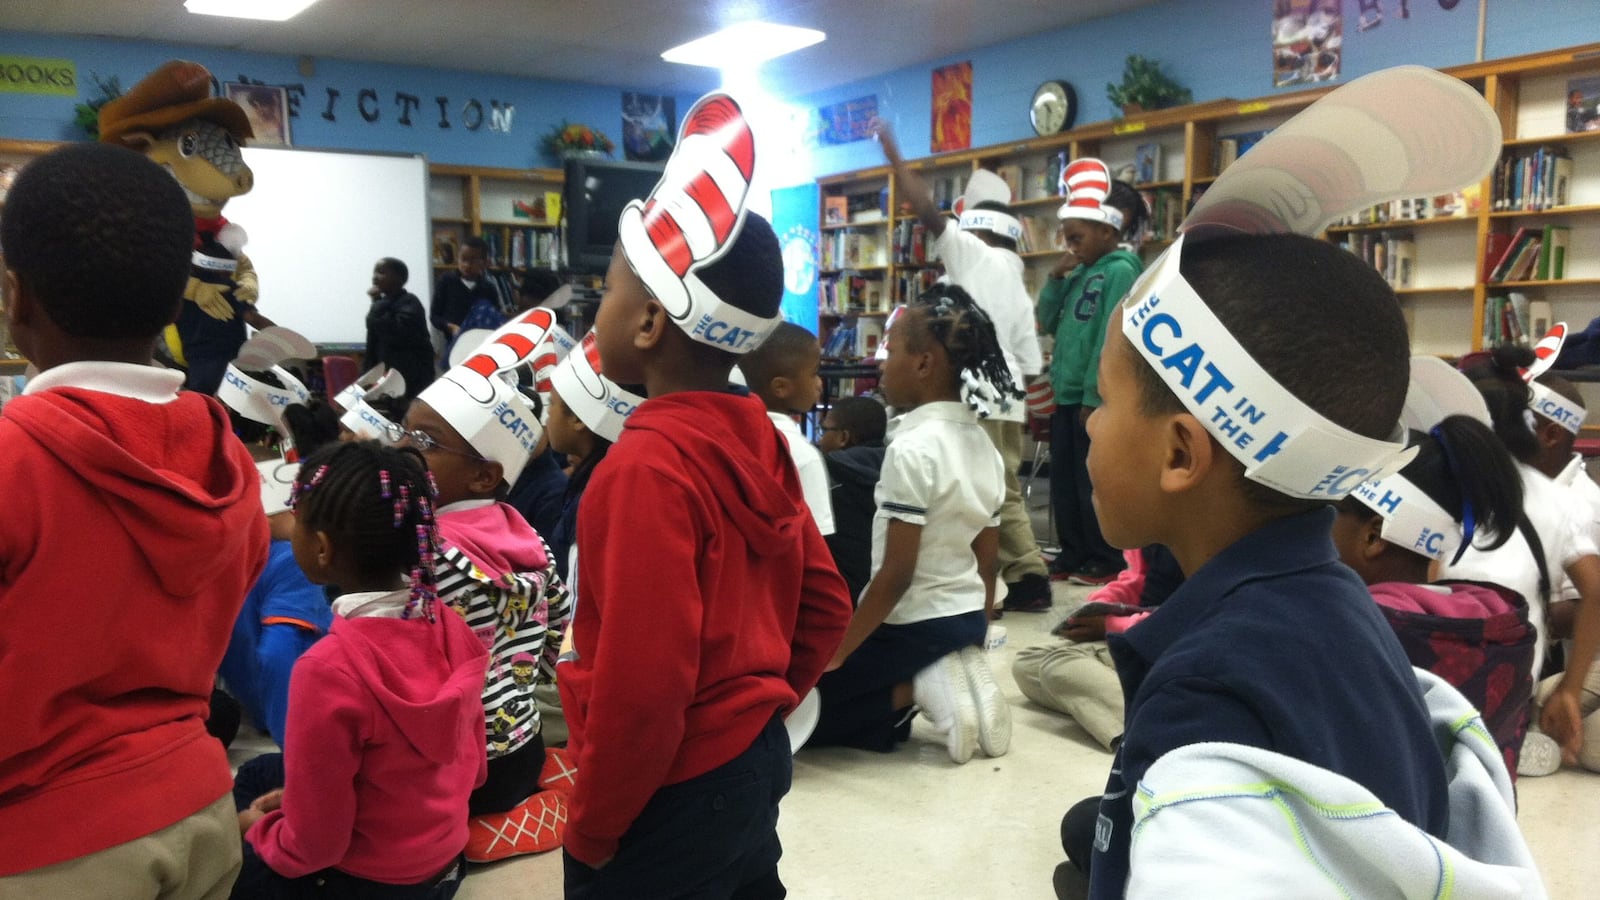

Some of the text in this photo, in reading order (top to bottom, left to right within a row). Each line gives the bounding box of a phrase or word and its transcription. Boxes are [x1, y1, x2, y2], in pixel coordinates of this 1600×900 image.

[693, 313, 713, 335] THE
[703, 321, 755, 348] CAT
[1128, 293, 1235, 406] THE CAT
[499, 408, 530, 439] CAT
[1234, 397, 1266, 425] IN
[1542, 401, 1574, 423] CAT
[1210, 406, 1255, 450] THE
[1309, 464, 1349, 496] THE
[1377, 489, 1403, 514] H
[1414, 526, 1431, 549] THE
